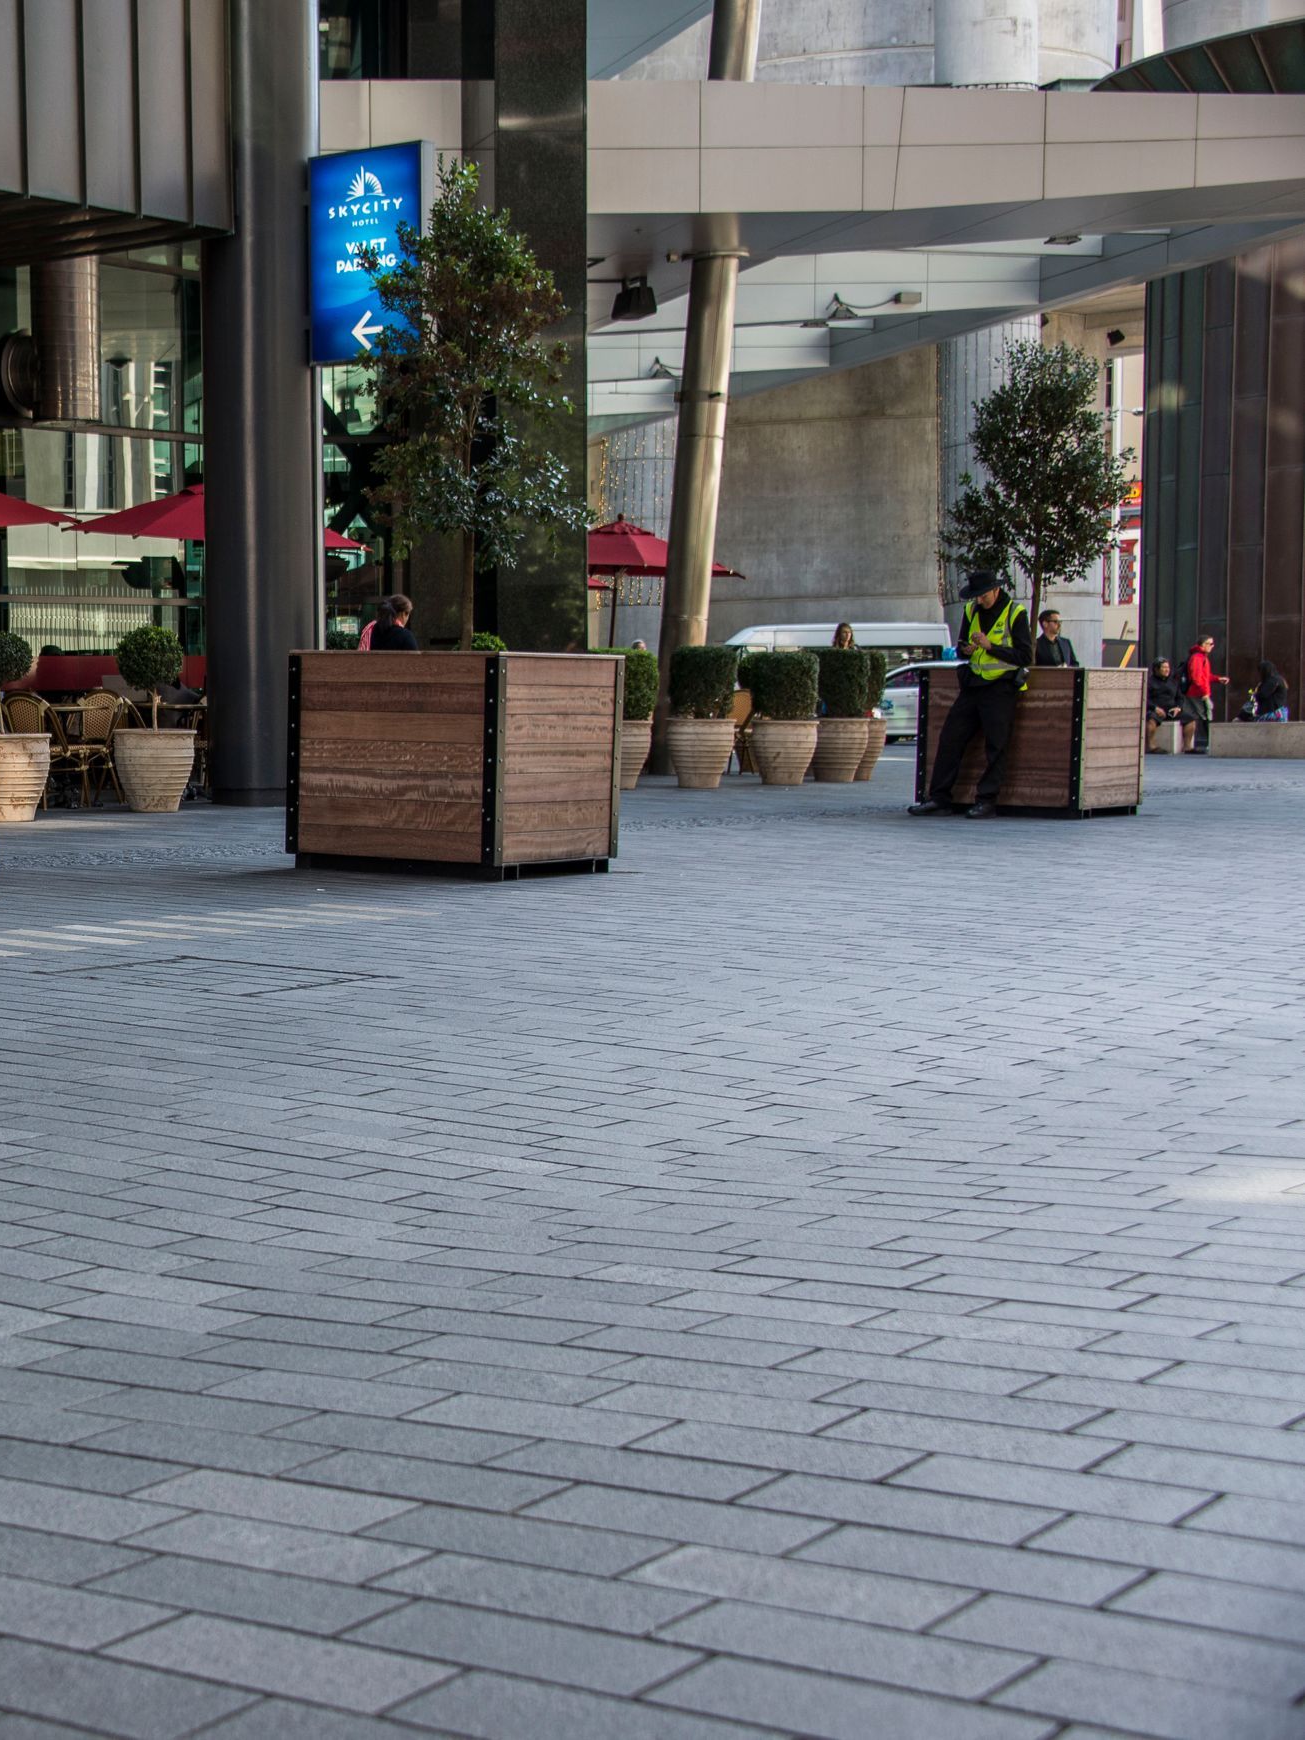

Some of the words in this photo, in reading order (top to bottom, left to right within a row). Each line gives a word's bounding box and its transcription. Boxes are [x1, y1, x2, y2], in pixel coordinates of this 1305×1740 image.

[328, 197, 403, 219] SKYCITY
[352, 218, 378, 227] HOTEL
[336, 253, 396, 274] PARNG
